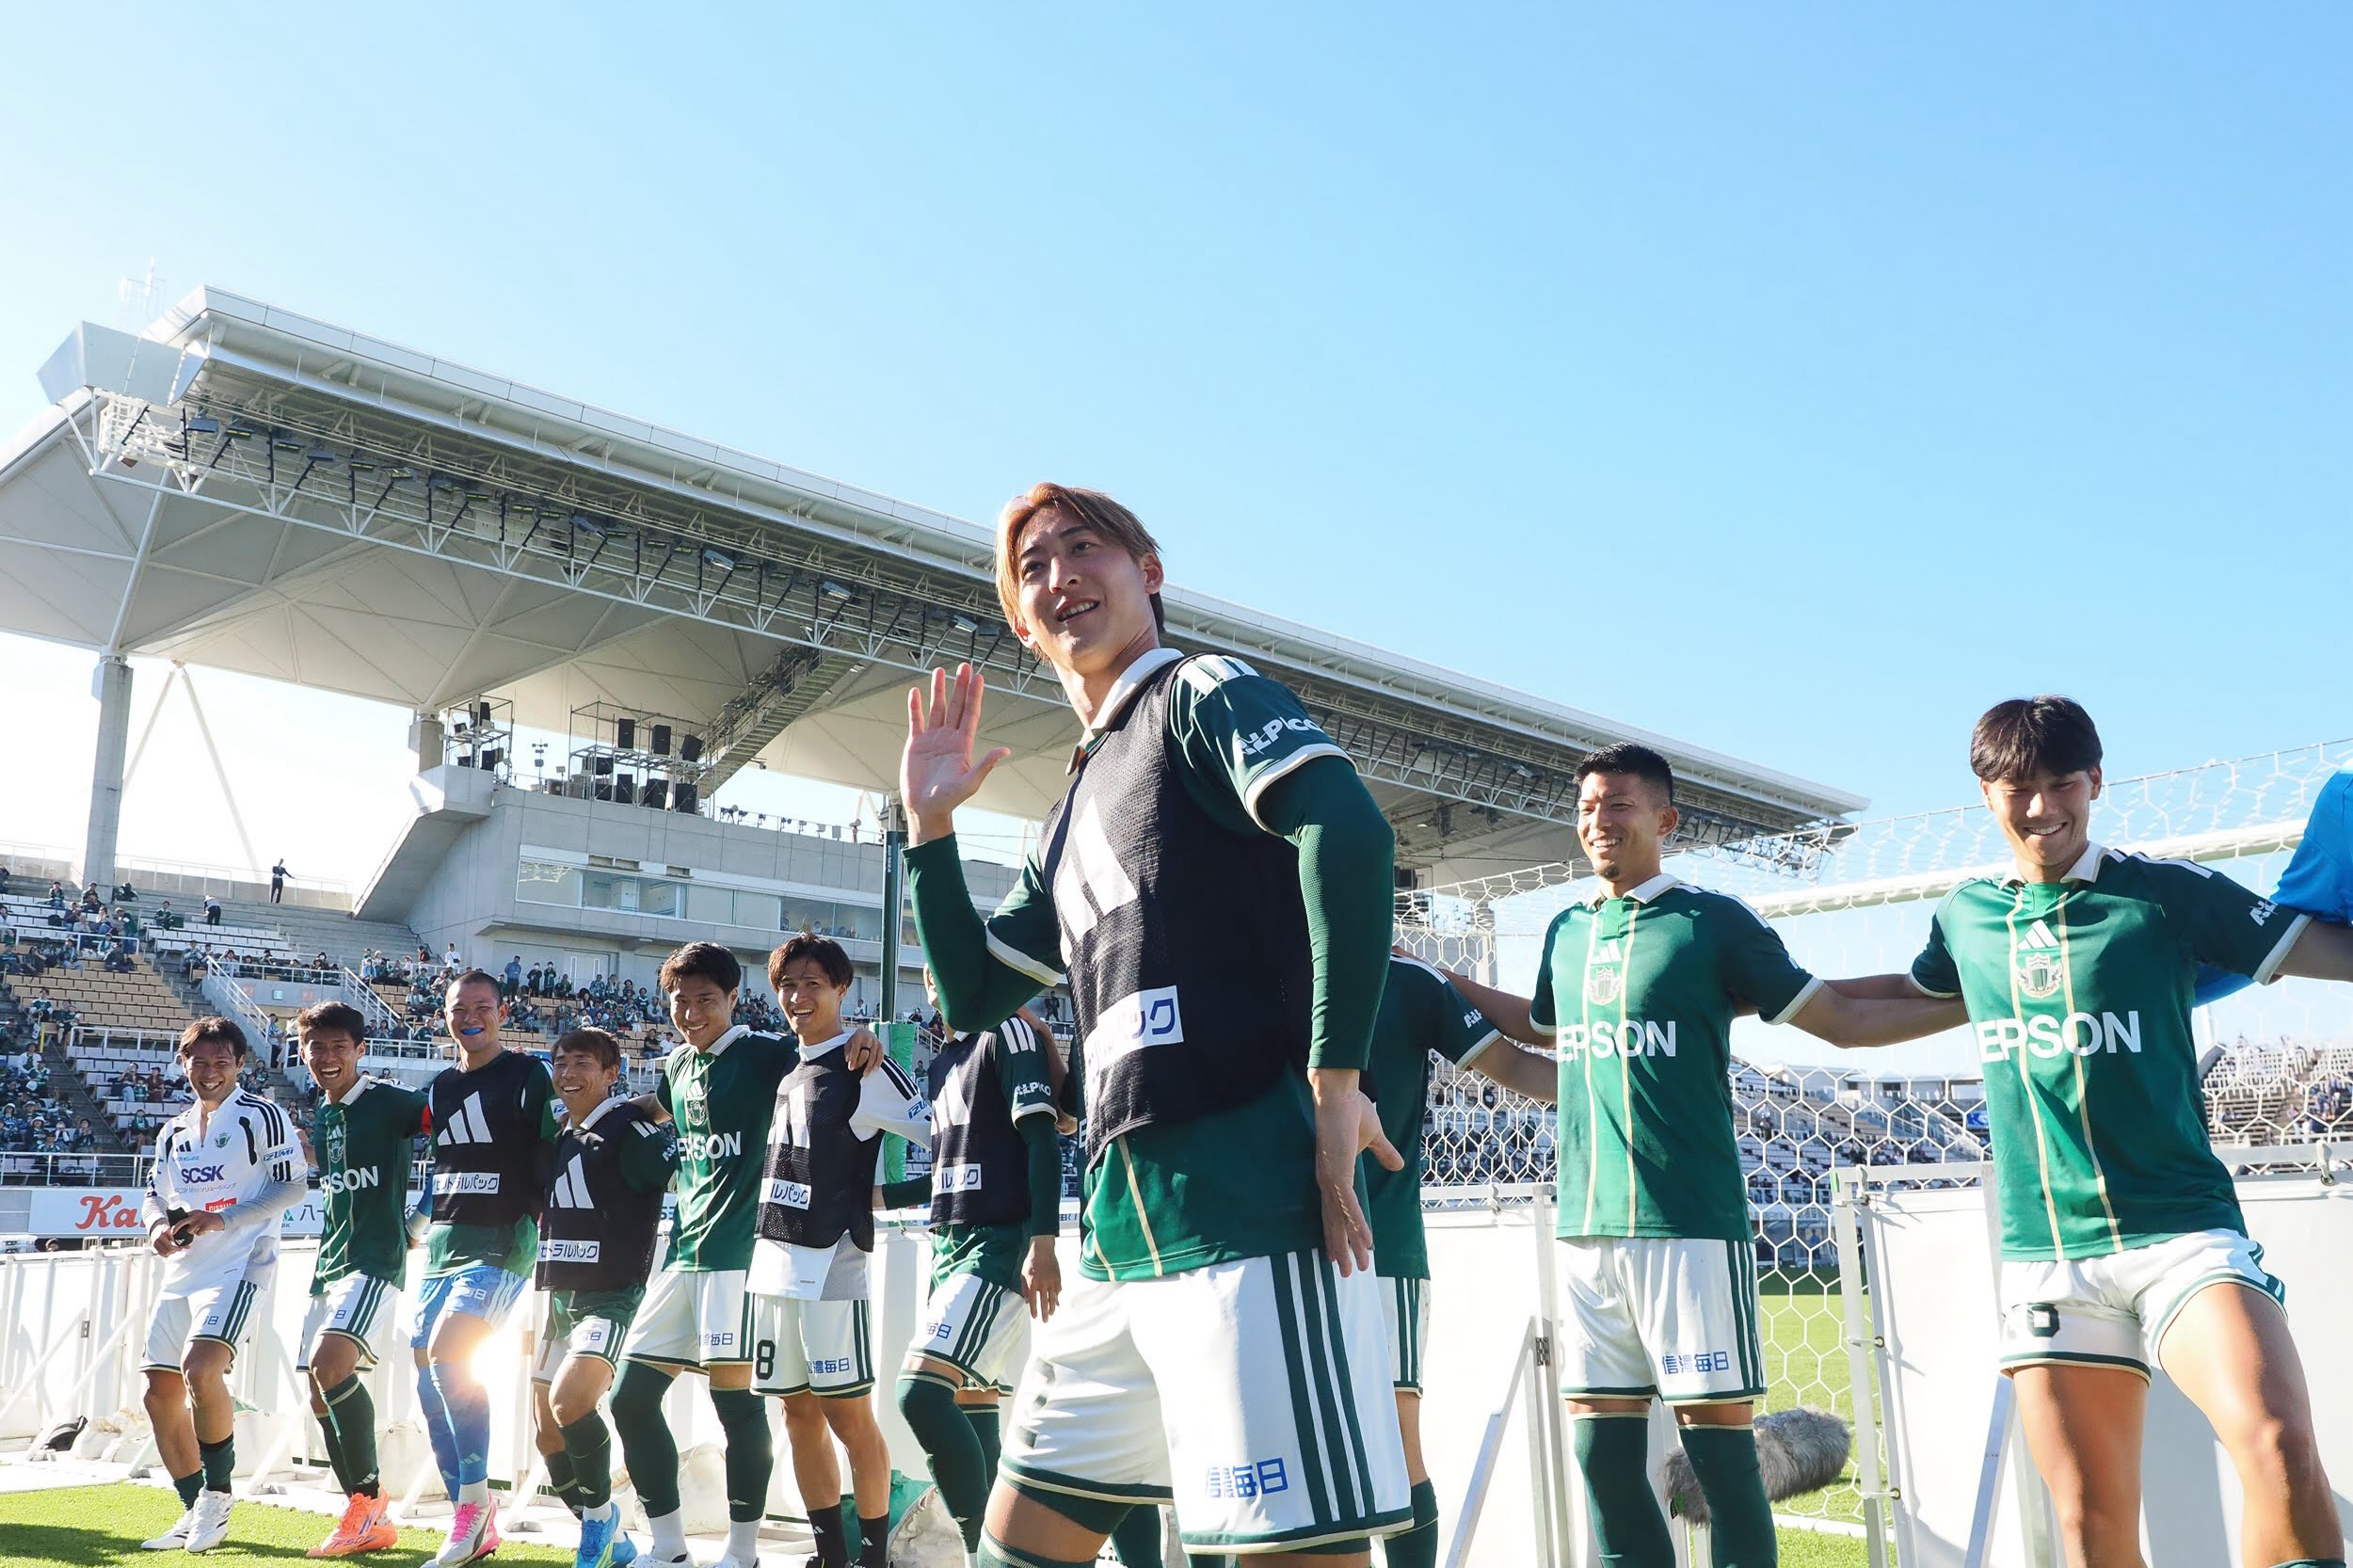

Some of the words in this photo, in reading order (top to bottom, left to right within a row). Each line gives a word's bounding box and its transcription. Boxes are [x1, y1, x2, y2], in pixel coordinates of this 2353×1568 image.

[1557, 1019, 1676, 1063] EPSON
[1977, 1010, 2142, 1064] EPSON
[181, 1164, 225, 1184] SCSK
[755, 1339, 776, 1380] 8
